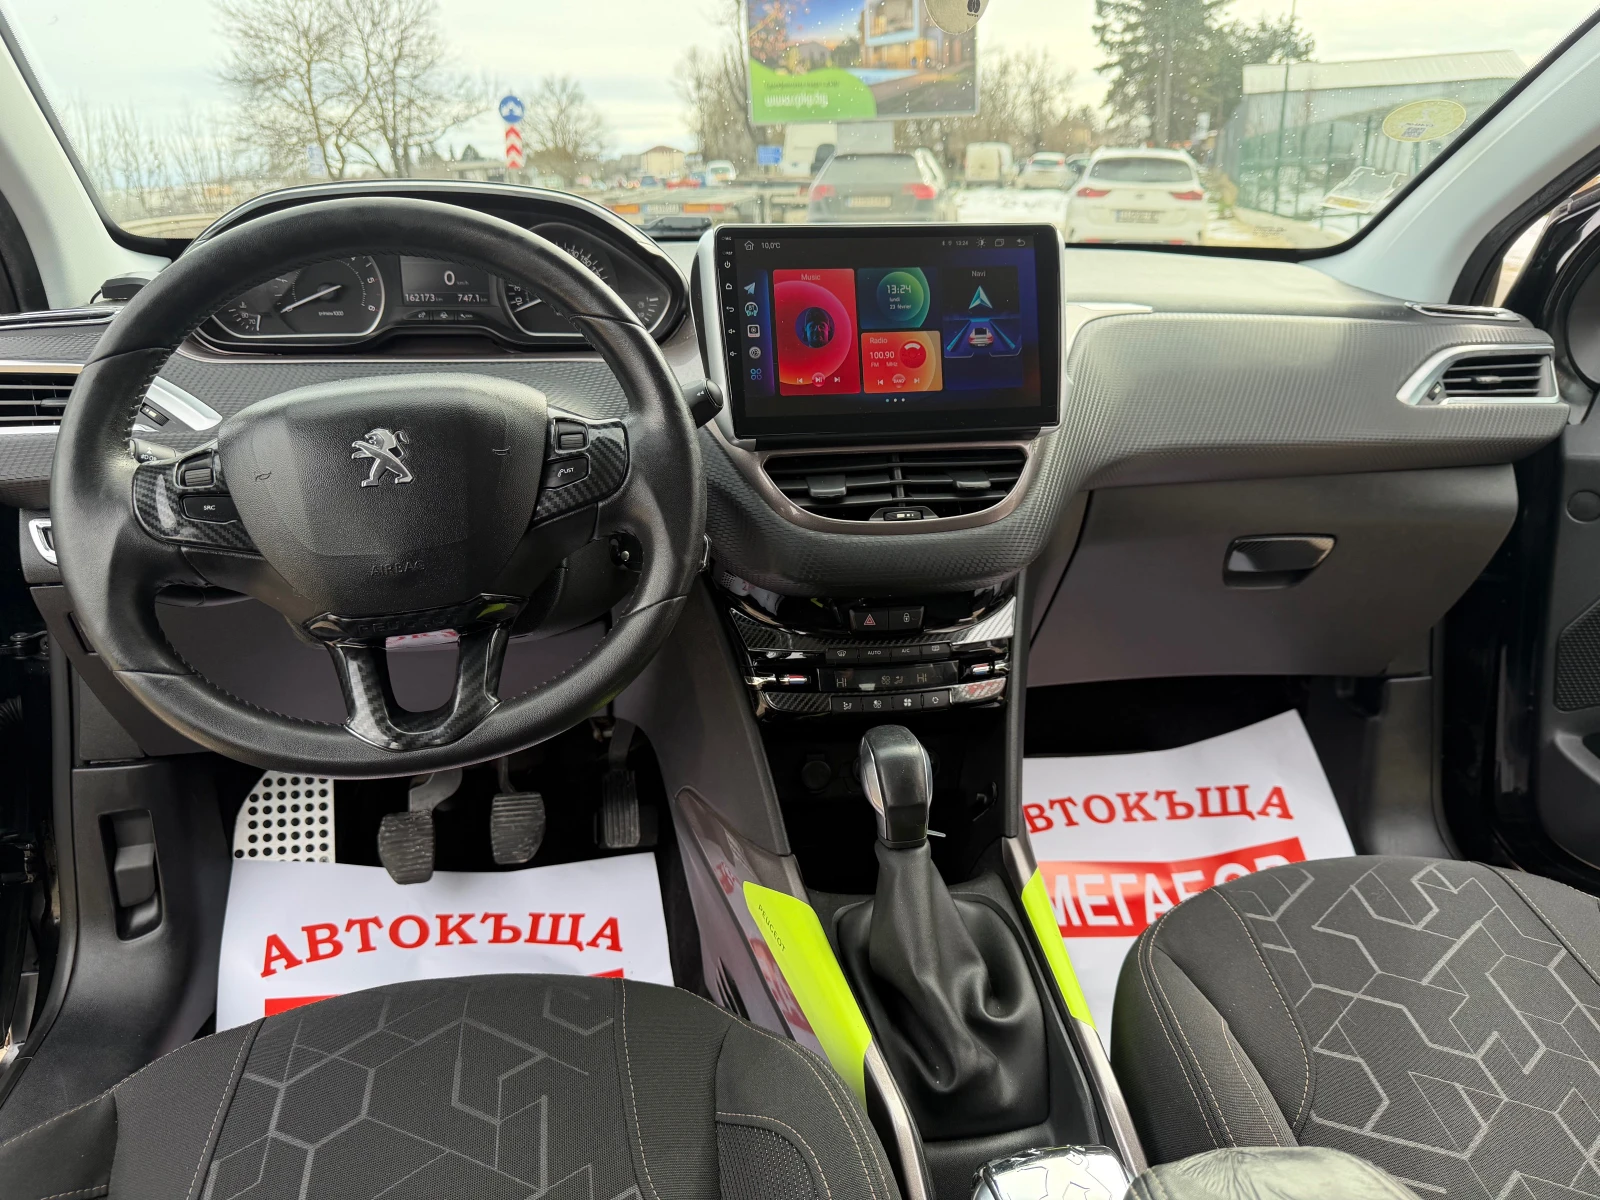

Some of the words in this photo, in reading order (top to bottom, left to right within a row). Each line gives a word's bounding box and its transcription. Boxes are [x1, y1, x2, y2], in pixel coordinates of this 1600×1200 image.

[443, 270, 456, 286] 0
[801, 273, 821, 281] Music
[886, 284, 912, 295] 13:24
[404, 293, 436, 303] 162173
[457, 293, 481, 303] 747.1
[869, 336, 888, 344] Radio
[869, 351, 895, 359] 100.90
[370, 560, 426, 577] AIRBAG
[836, 677, 847, 688] HI
[916, 673, 927, 683] HI
[1022, 785, 1294, 834] ВТОКЪЩА
[757, 903, 787, 953] PEUGEOT
[260, 911, 624, 978] АВТОКЪЩА
